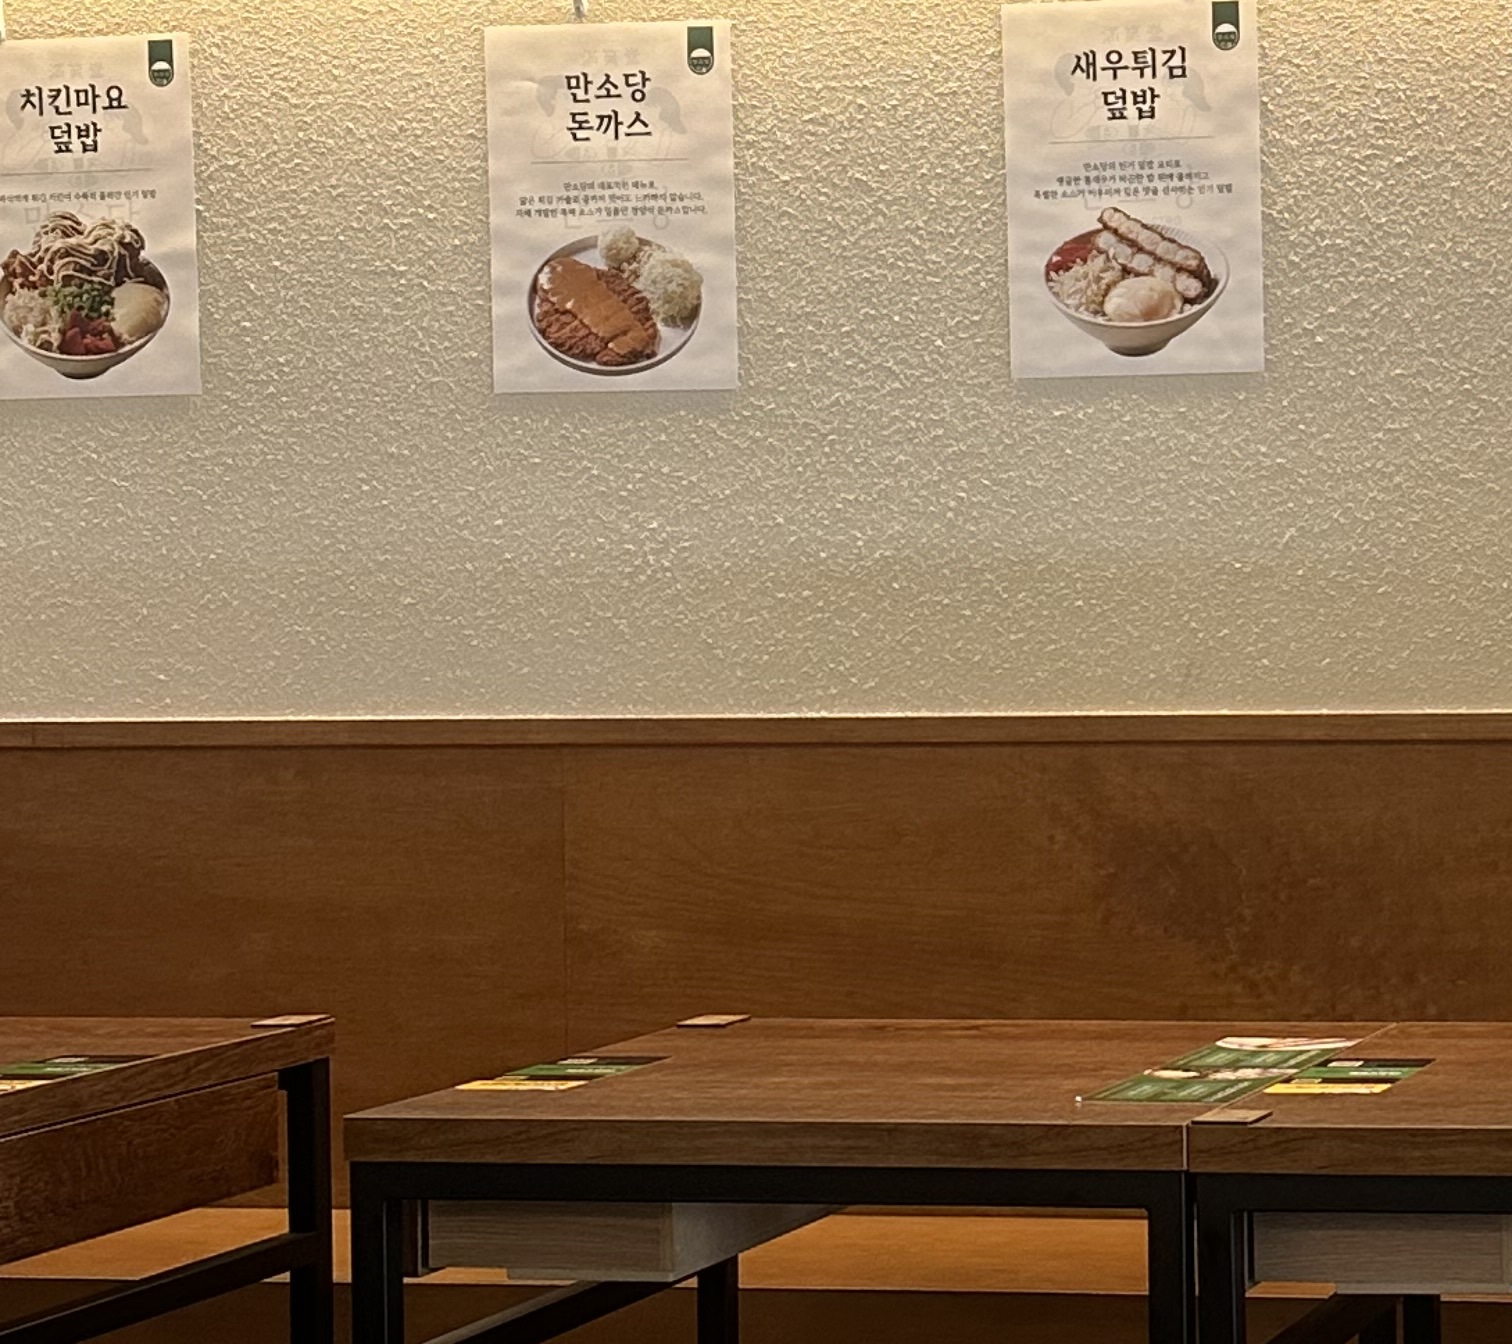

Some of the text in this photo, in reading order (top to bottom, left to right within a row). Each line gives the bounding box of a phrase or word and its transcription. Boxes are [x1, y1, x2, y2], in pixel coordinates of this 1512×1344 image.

[1071, 45, 1187, 82] 새우튀김
[20, 83, 129, 117] 치킨마요
[565, 69, 651, 103] 만소당
[1101, 86, 1161, 121] 덮밥
[48, 120, 102, 154] 덮밥
[566, 109, 652, 142] 돈까스
